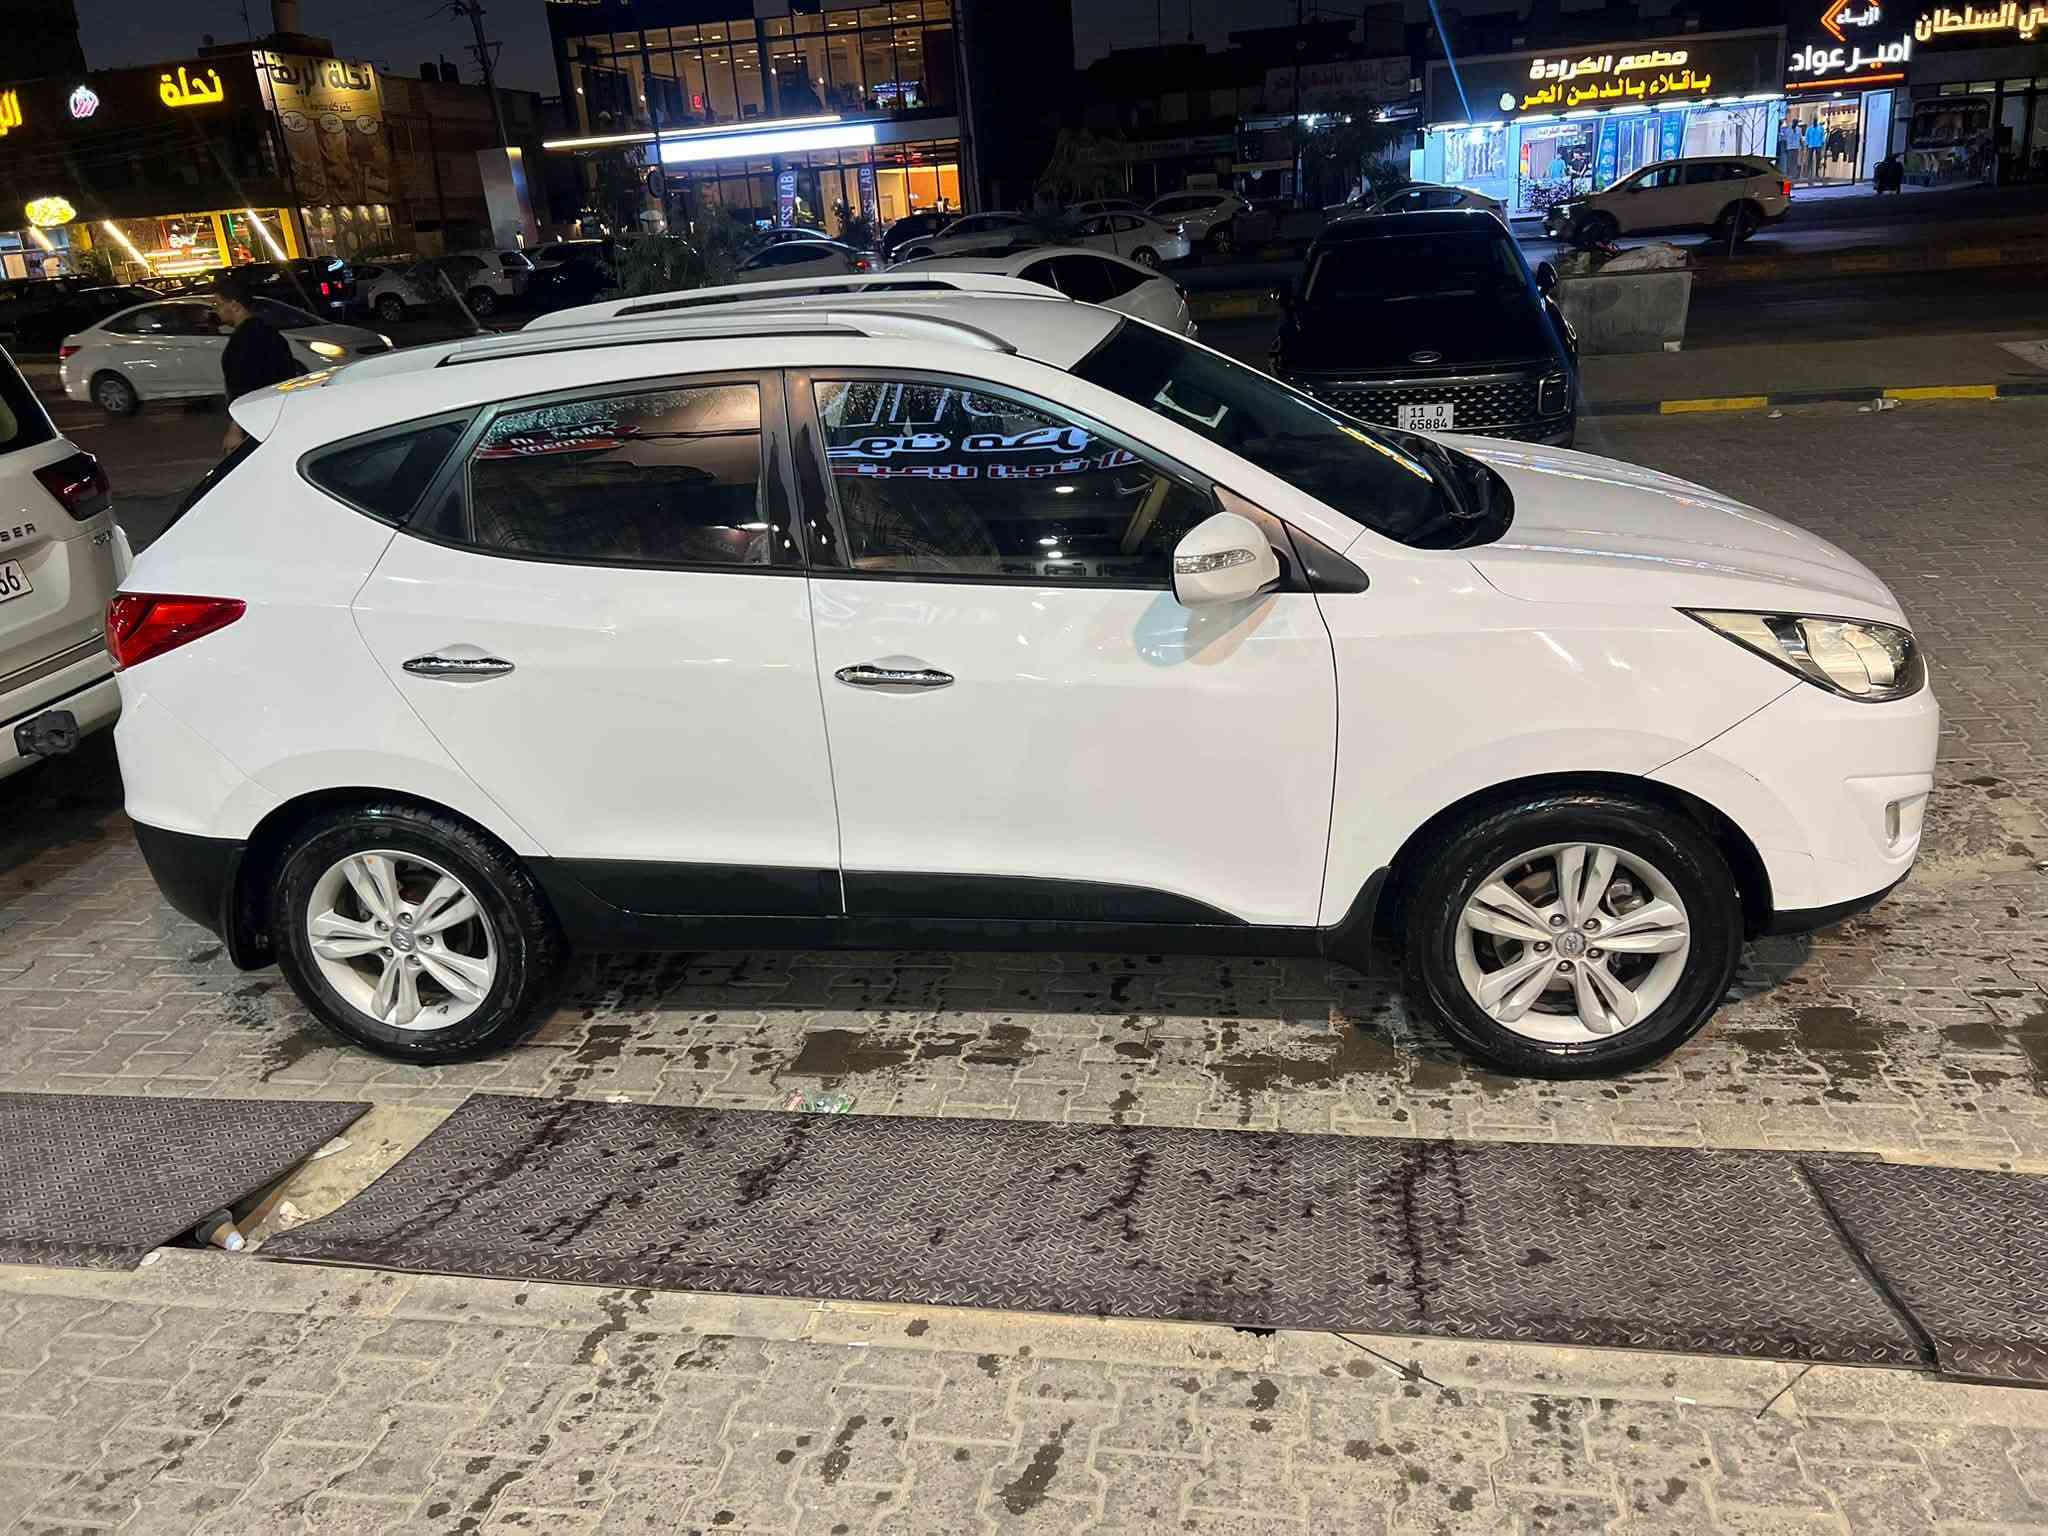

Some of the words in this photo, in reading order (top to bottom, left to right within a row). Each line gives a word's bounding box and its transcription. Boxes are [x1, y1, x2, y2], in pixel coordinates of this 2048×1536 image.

[1914, 2, 2017, 42] السلطان
[1613, 50, 1688, 76] مطعم
[1844, 33, 1912, 73] امير
[1529, 55, 1612, 82] الكرادة
[159, 66, 225, 108] نحلة
[1566, 77, 1646, 107] بالدهن
[1649, 69, 1712, 95] باقلاء
[1519, 83, 1563, 110] الحر
[781, 175, 794, 197] LAB
[861, 168, 873, 191] LAB
[1410, 408, 1424, 418] 11
[1410, 418, 1447, 430] 65884
